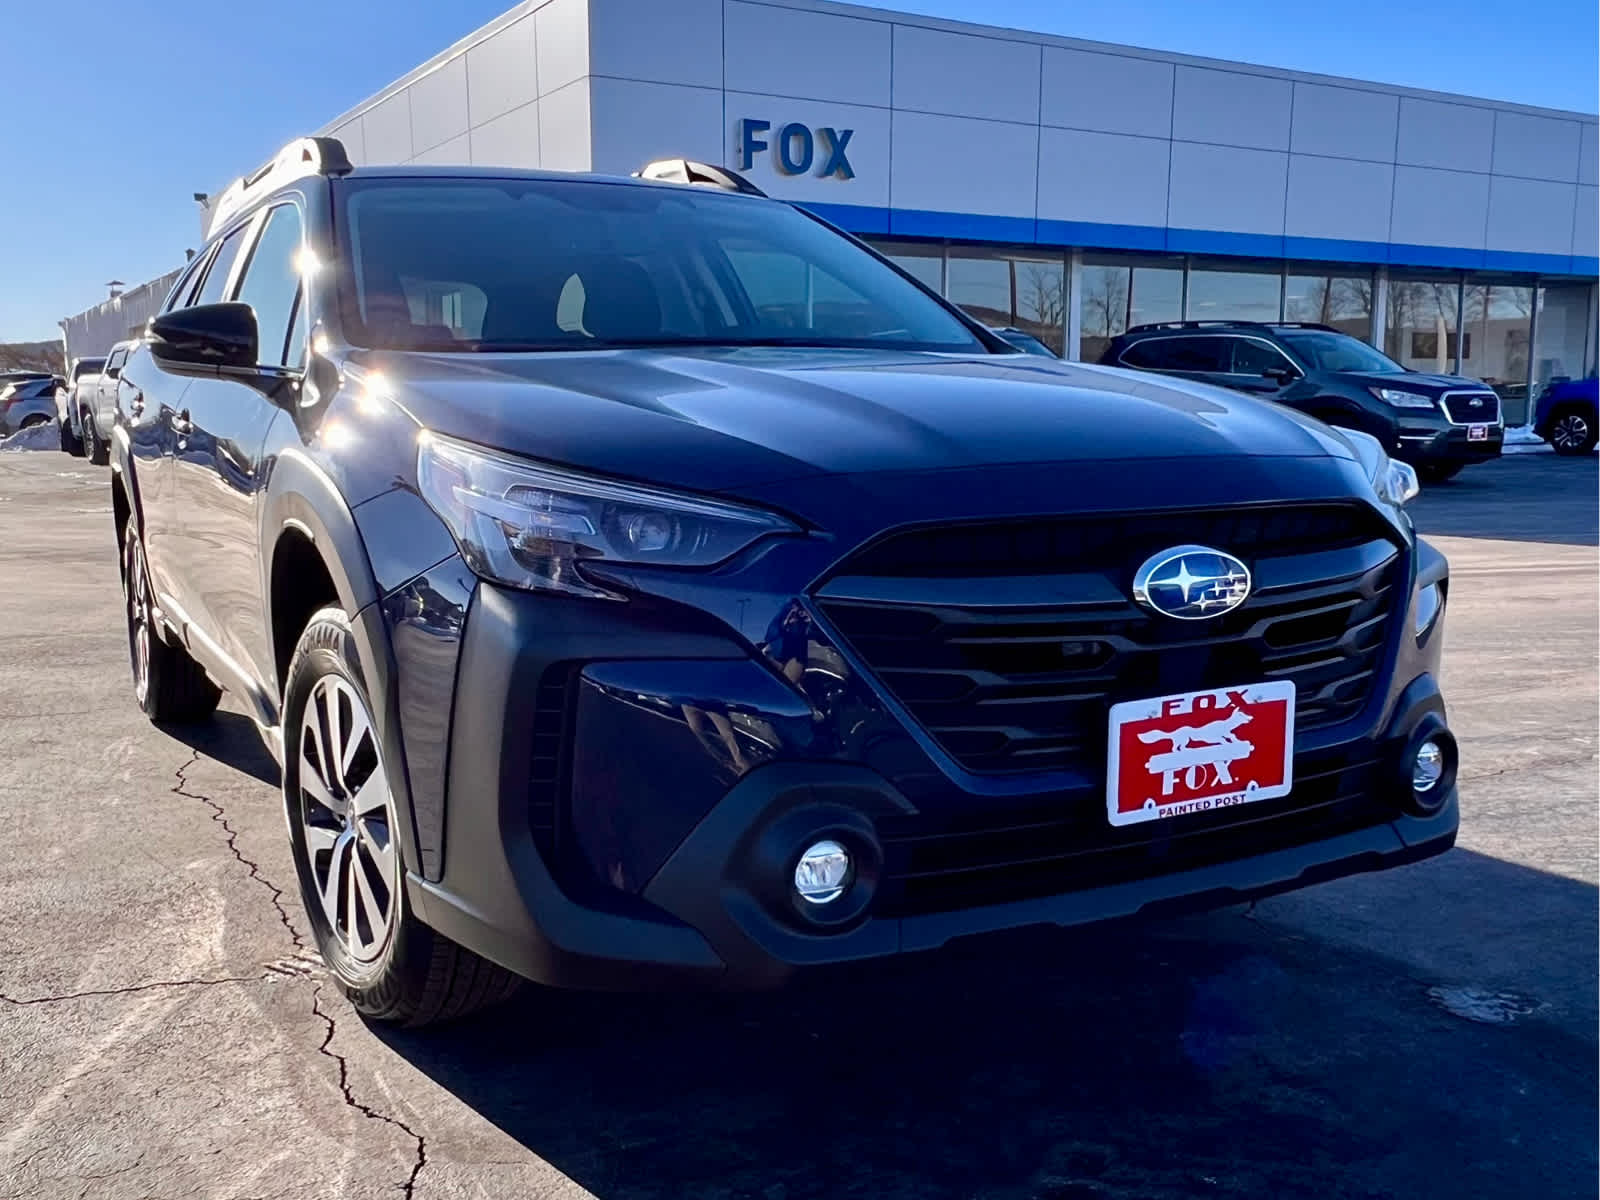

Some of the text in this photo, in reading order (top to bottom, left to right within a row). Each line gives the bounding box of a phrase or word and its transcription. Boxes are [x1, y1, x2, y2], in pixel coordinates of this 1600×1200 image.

[740, 118, 856, 180] FOX
[1161, 689, 1249, 718] FOX
[1158, 793, 1247, 818] PAINTED POST
